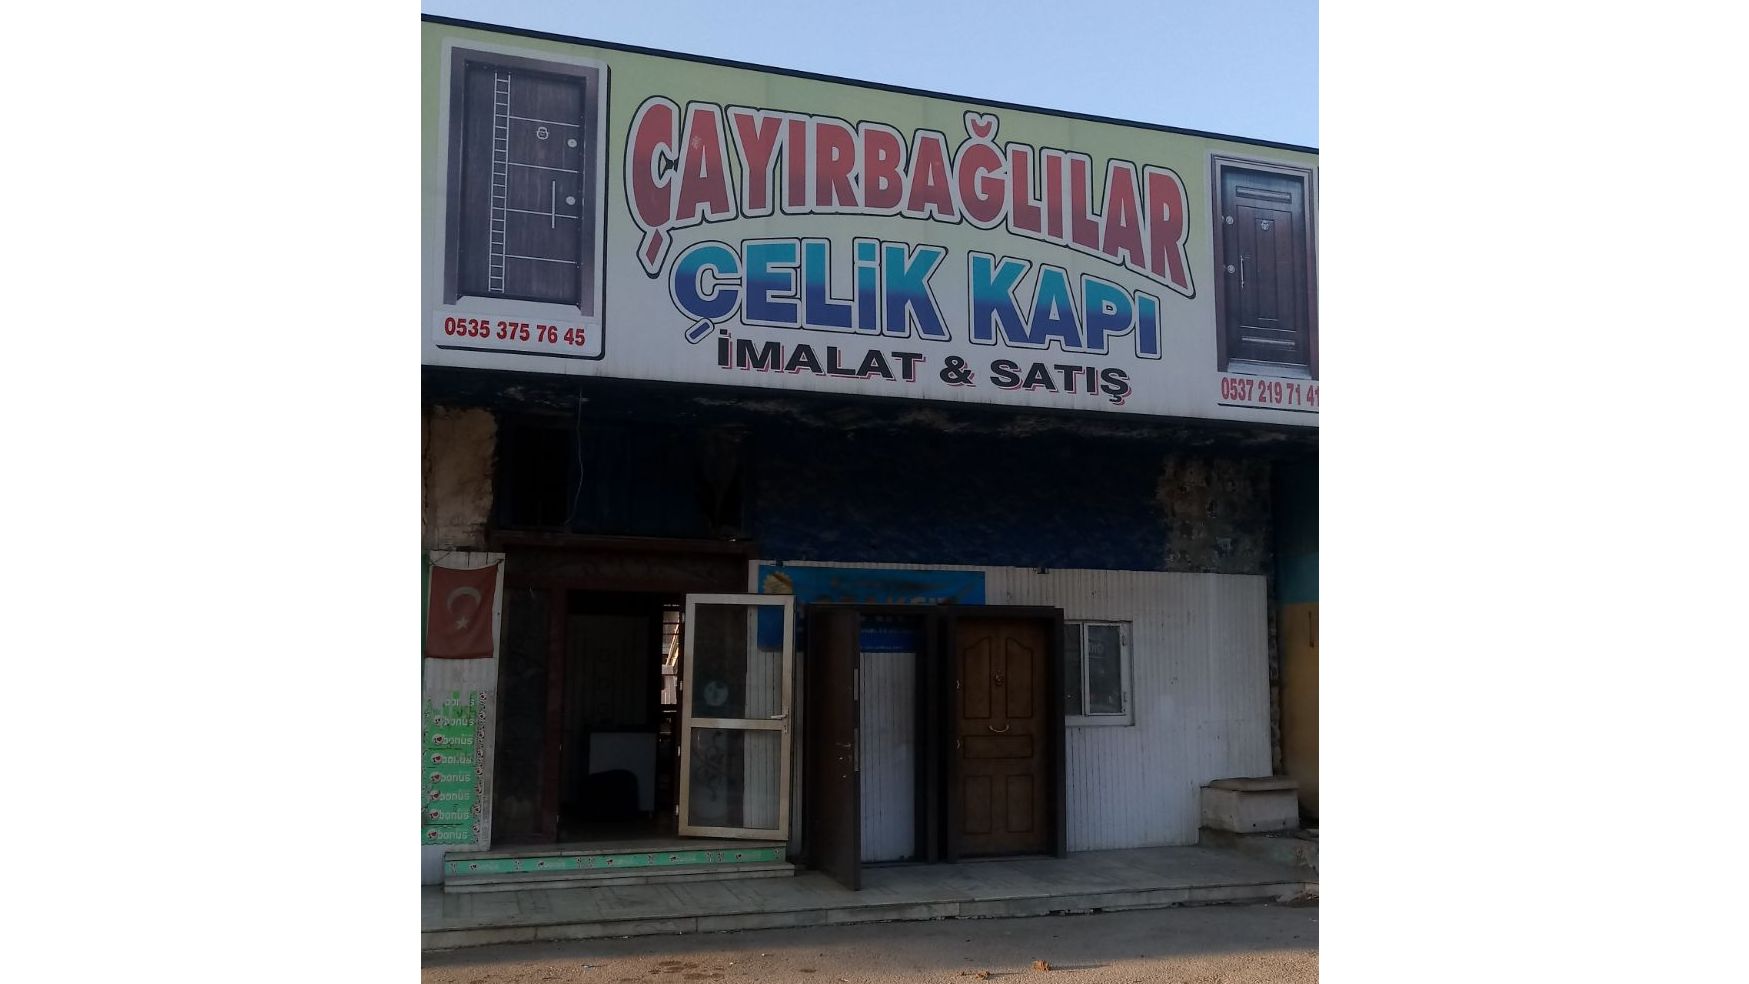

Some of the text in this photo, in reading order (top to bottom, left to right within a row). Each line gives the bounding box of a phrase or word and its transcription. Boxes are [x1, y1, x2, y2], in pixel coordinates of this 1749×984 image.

[629, 98, 1191, 293] ÇAYIRBAĞLILAR
[444, 316, 586, 347] 0535 375 76 45
[970, 253, 1158, 356] KAPI
[717, 329, 1131, 405] İMALAT & SATIŞ
[1221, 376, 1254, 401] 0537
[1258, 380, 1283, 404] 219
[1286, 382, 1301, 406] 71
